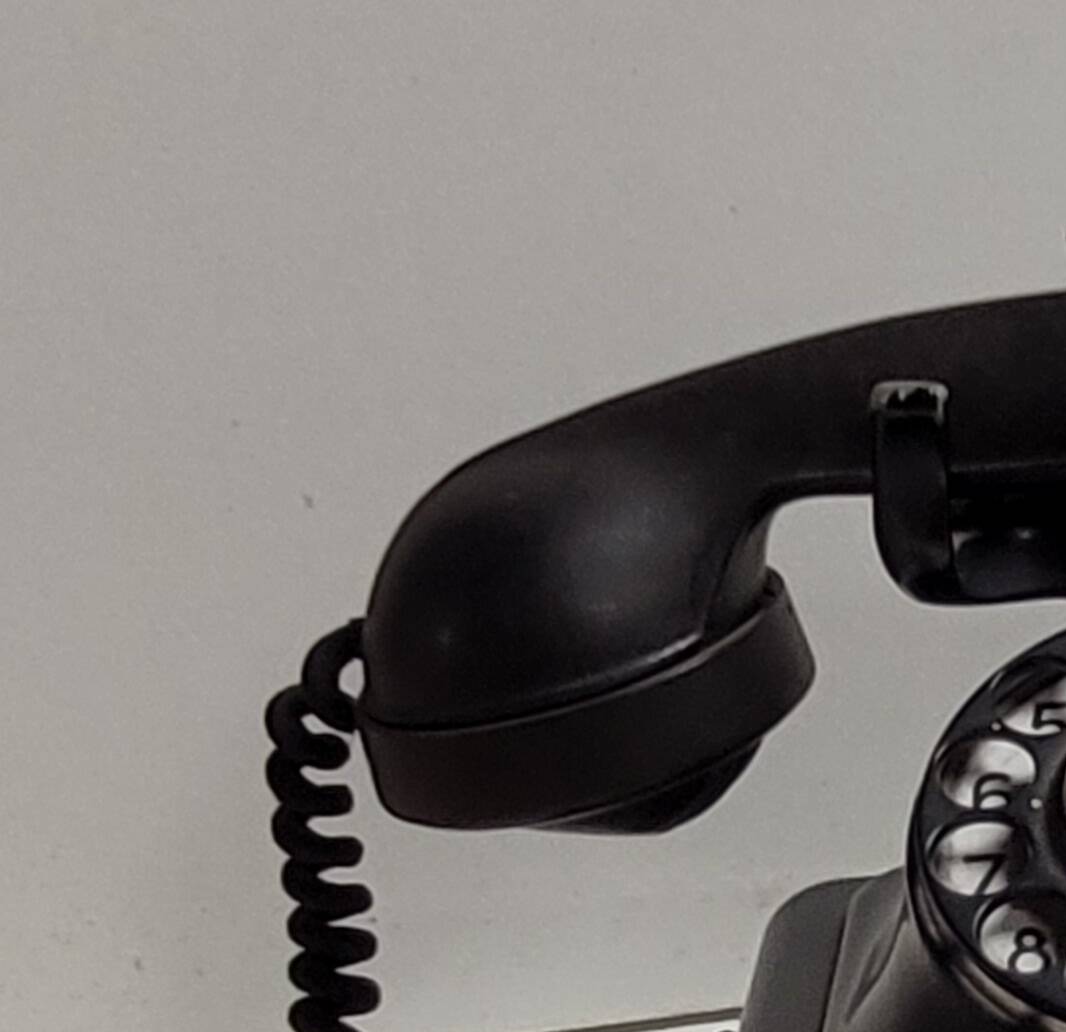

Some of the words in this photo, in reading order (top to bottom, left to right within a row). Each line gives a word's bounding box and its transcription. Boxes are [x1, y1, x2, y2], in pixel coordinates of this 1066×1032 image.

[973, 771, 1011, 810] 6
[962, 853, 1006, 896] 7
[1007, 927, 1049, 975] 8
